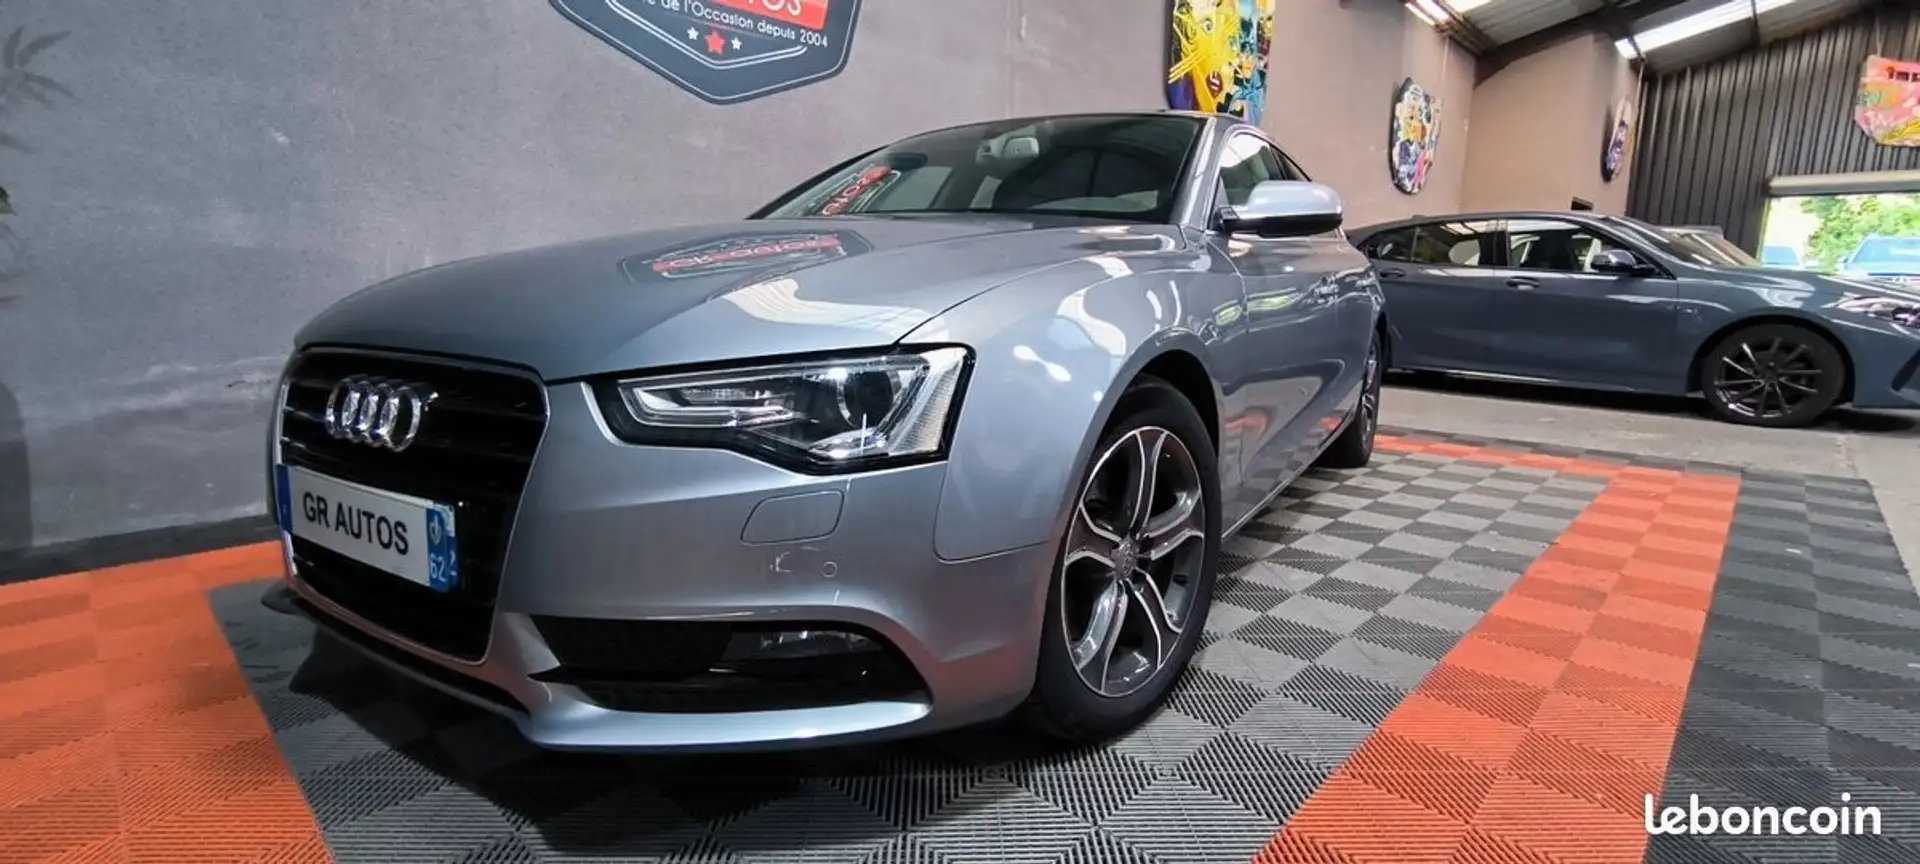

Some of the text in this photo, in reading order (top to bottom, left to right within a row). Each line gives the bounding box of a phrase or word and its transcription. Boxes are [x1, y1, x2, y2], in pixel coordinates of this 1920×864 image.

[757, 20, 796, 40] depuis
[800, 29, 828, 47] 2004
[303, 491, 409, 556] GR AUTOS
[430, 552, 447, 582] 62
